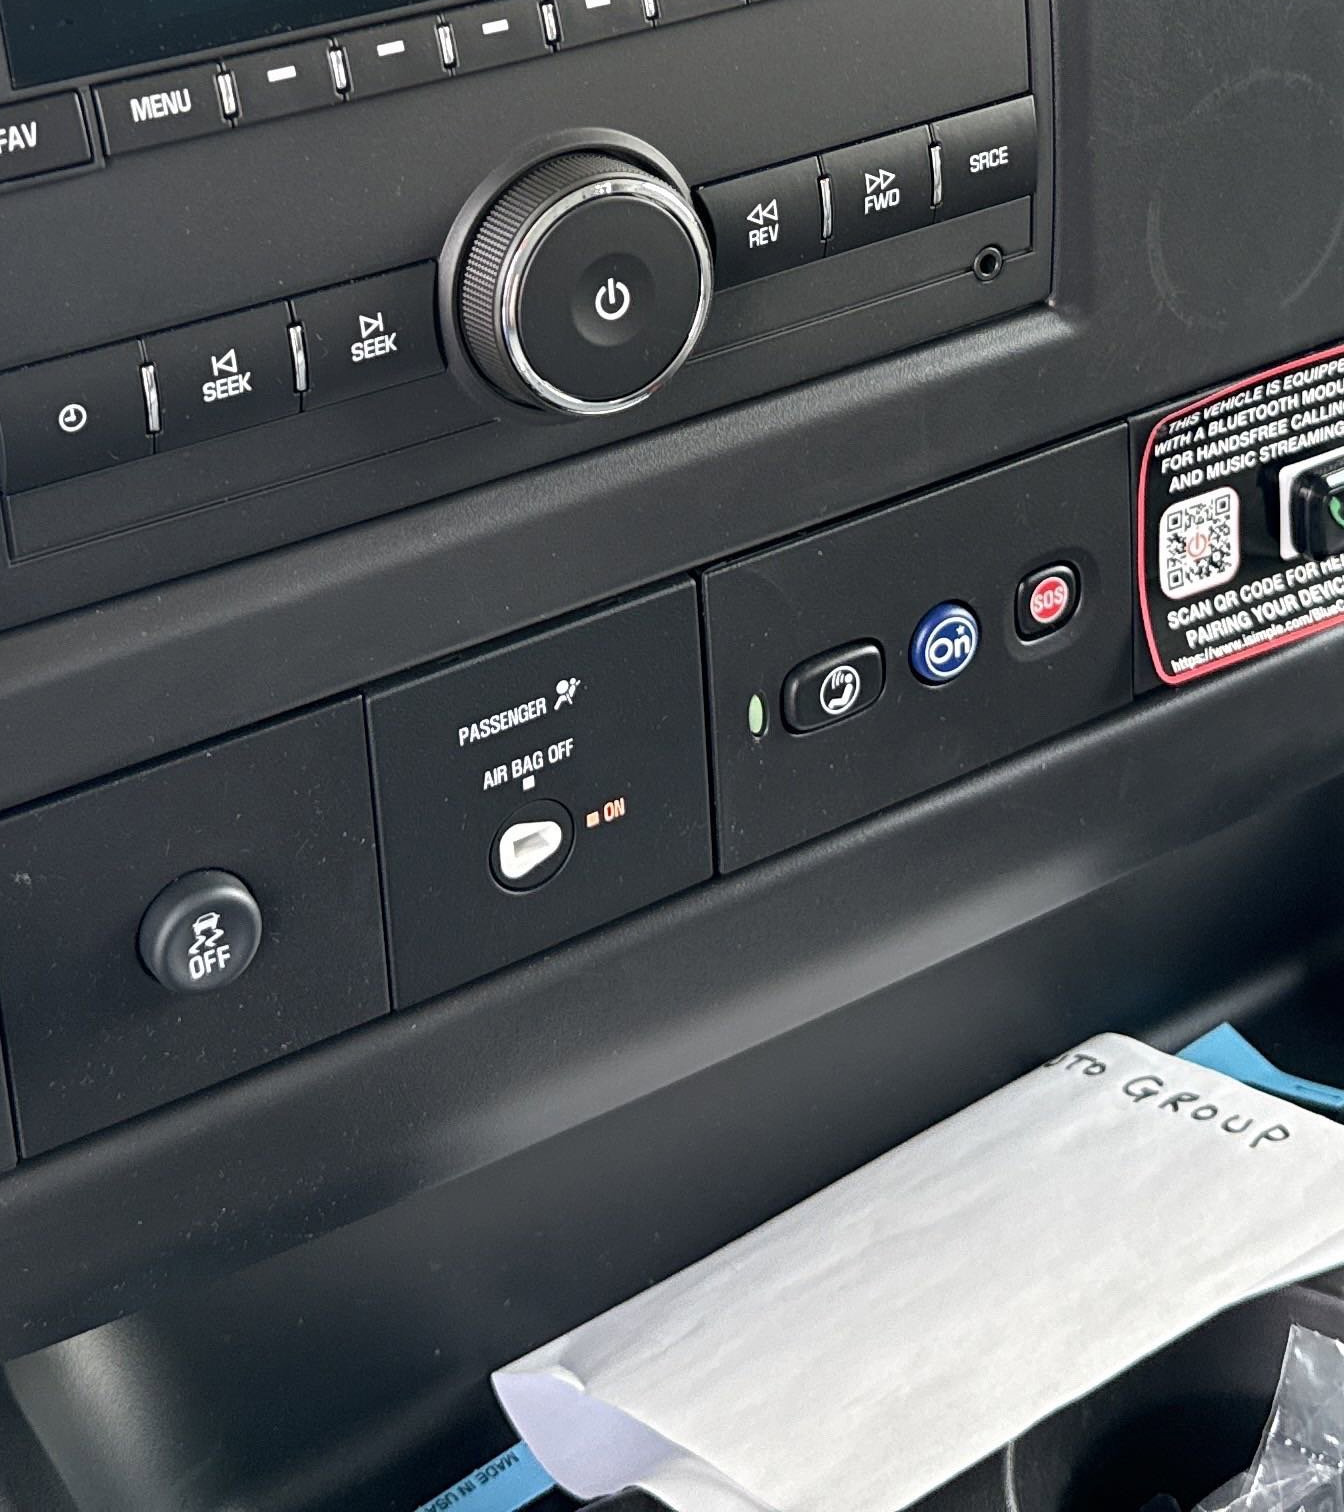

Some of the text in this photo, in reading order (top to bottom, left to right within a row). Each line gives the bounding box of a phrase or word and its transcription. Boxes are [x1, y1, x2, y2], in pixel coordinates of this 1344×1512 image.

[130, 88, 192, 123] MENU
[969, 145, 1009, 173] SRCE
[864, 188, 900, 216] FWD
[748, 224, 779, 249] REV
[350, 332, 398, 364] SEEK
[202, 371, 253, 403] SEEK
[1154, 433, 1193, 457] WITH
[1193, 426, 1205, 442] A
[1207, 392, 1300, 438] BLUETOOTH
[1168, 412, 1201, 435] THIS
[1203, 386, 1264, 421] VEHICLE
[1266, 379, 1282, 398] IS
[1161, 450, 1195, 474] FOR
[1197, 417, 1288, 461] HANDSFREE
[1169, 468, 1205, 494] AND
[1206, 451, 1257, 481] MUSIC
[1032, 586, 1066, 613] SOS
[1167, 601, 1215, 630] SCAN
[1213, 591, 1240, 610] QR
[1240, 573, 1286, 601] CODE
[1286, 561, 1322, 588] FOR
[1185, 611, 1254, 650] PAIRING
[1256, 593, 1301, 624] YOUR
[458, 697, 547, 746] PASSENGER
[483, 738, 574, 790] AIR BAG OFF
[603, 798, 626, 822] ON
[189, 944, 230, 980] OFF
[1121, 1075, 1291, 1149] GROUP
[475, 1450, 520, 1485] MADE
[456, 1480, 477, 1497] IN
